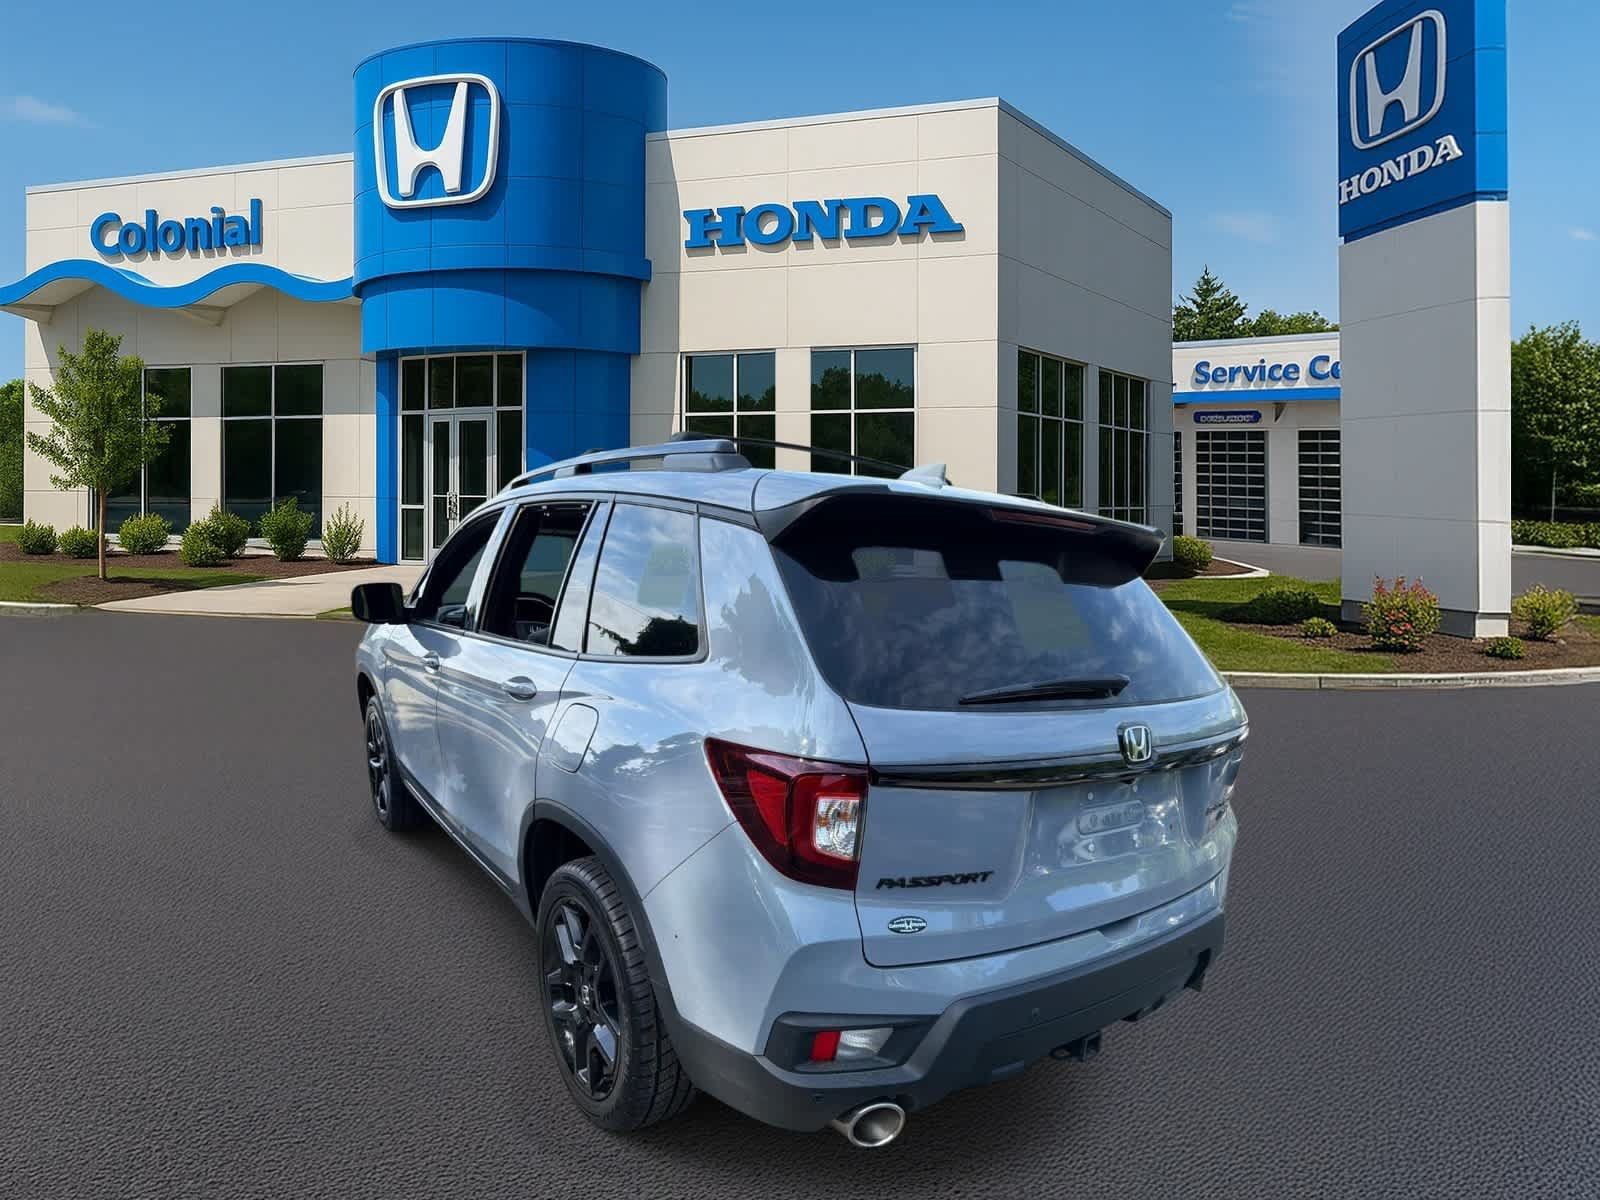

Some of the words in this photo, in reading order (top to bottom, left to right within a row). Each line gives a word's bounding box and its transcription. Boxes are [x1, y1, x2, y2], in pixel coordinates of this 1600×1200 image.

[1338, 134, 1463, 205] HONDA
[90, 198, 262, 256] Colonial
[683, 194, 965, 249] HONDA
[1194, 358, 1300, 384] Service
[875, 870, 995, 890] PASSPORT
